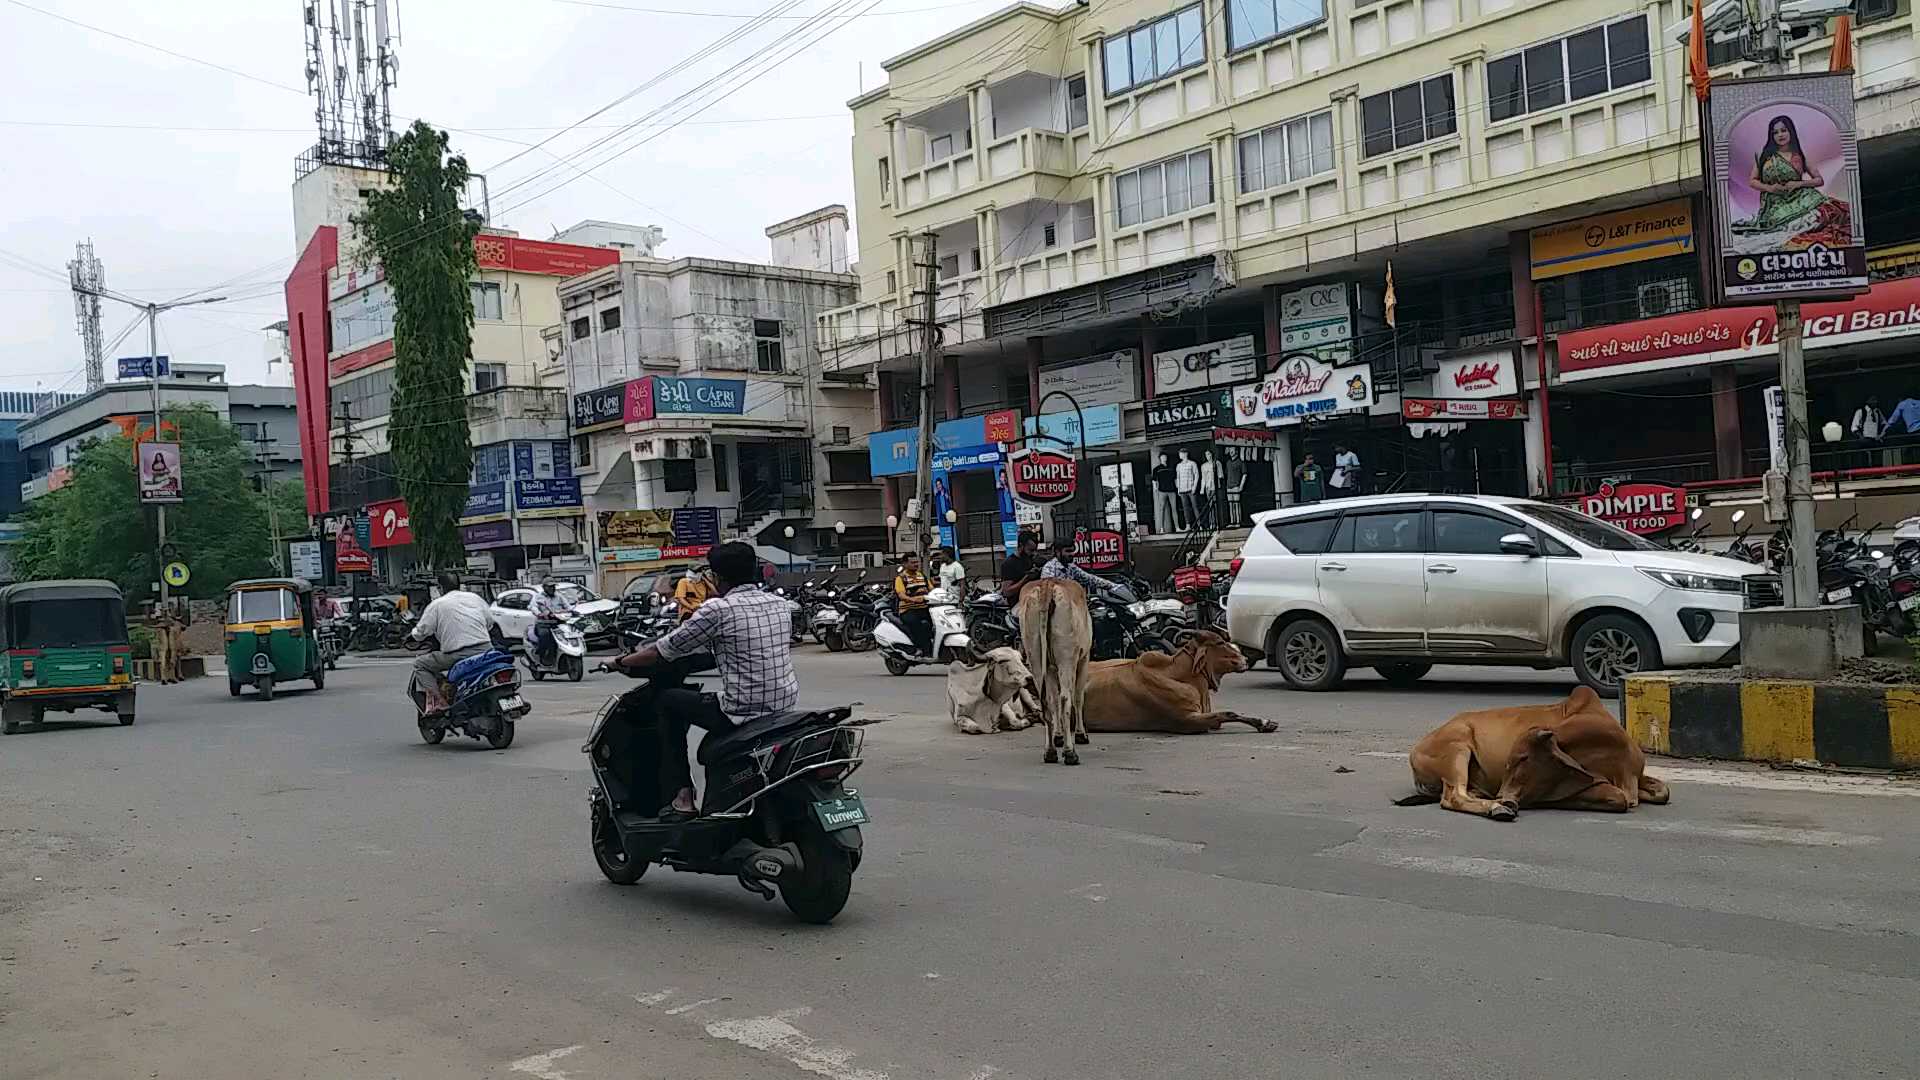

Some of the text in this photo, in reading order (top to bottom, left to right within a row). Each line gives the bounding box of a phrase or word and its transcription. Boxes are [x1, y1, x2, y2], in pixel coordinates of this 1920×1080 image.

[1609, 216, 1686, 241] L&T Finance
[474, 240, 505, 253] HDFC
[1771, 313, 1845, 343] IICI
[1850, 303, 1920, 333] Bank
[1454, 361, 1500, 388] Vadilal
[696, 386, 736, 403] CAPRI
[1262, 370, 1333, 405] Madhav
[596, 394, 620, 414] CAPRI
[710, 400, 736, 410] LOANS
[1148, 403, 1217, 428] RASCAL
[952, 455, 965, 466] Gold
[965, 453, 979, 464] Loan
[1023, 463, 1076, 480] DIMPLE
[1030, 480, 1069, 494] FAST FOOD
[1587, 493, 1676, 516] DIMPLE
[1632, 517, 1667, 529] FOOD
[824, 807, 864, 825] Tunwal
